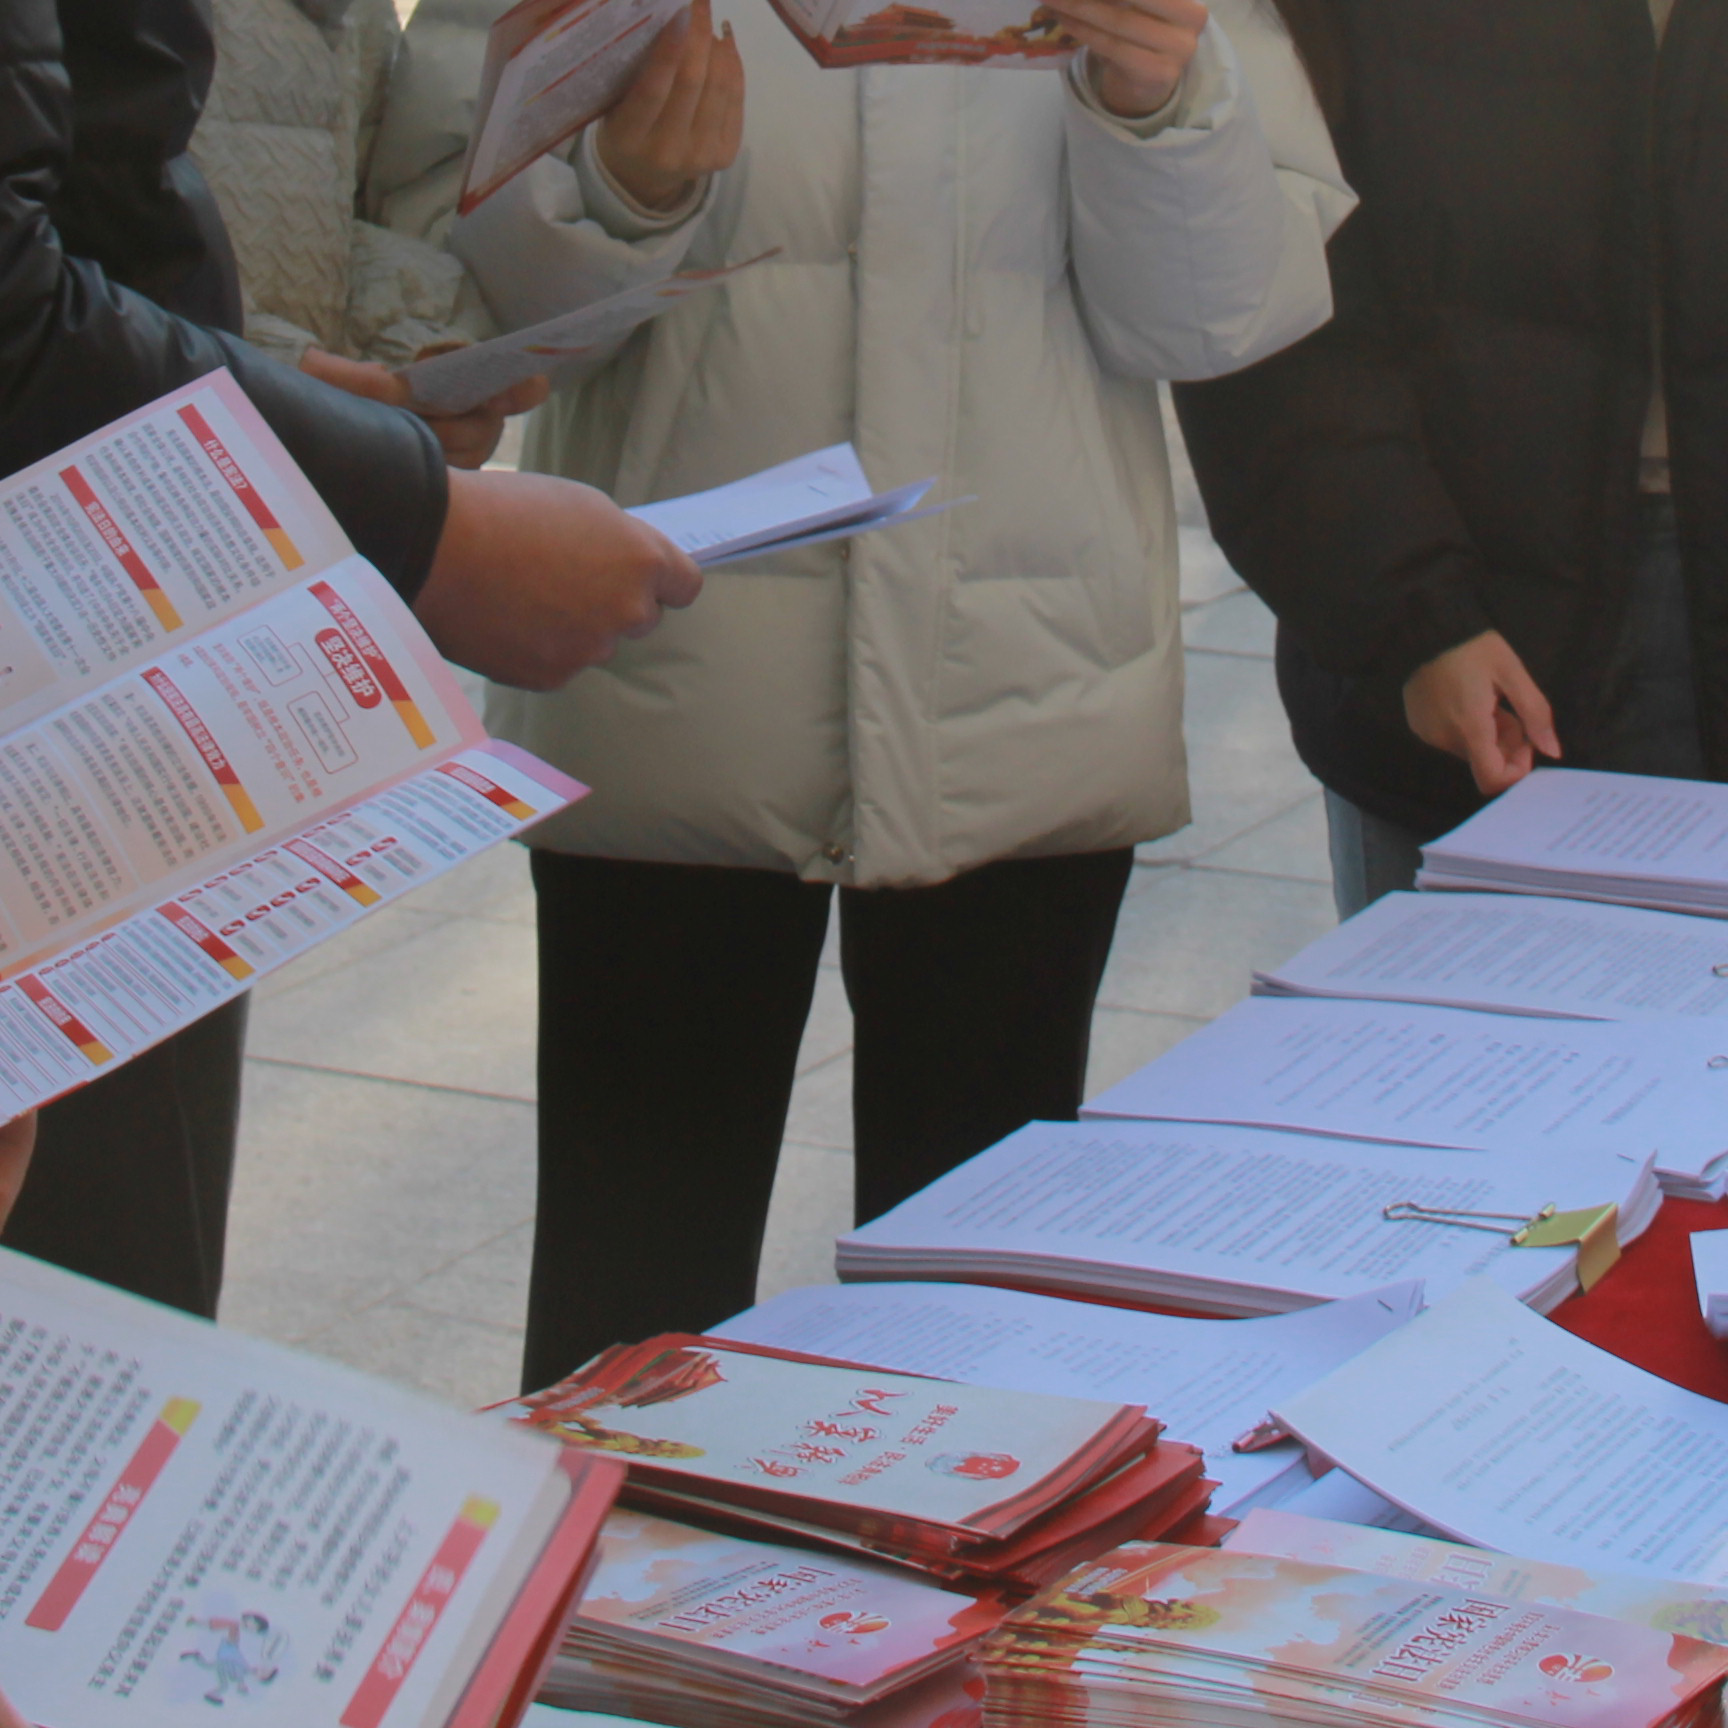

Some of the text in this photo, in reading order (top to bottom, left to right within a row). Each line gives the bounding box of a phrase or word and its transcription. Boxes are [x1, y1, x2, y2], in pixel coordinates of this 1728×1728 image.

[320, 632, 375, 701] 坚决维护
[1371, 1597, 1510, 1684] 国家宪法日
